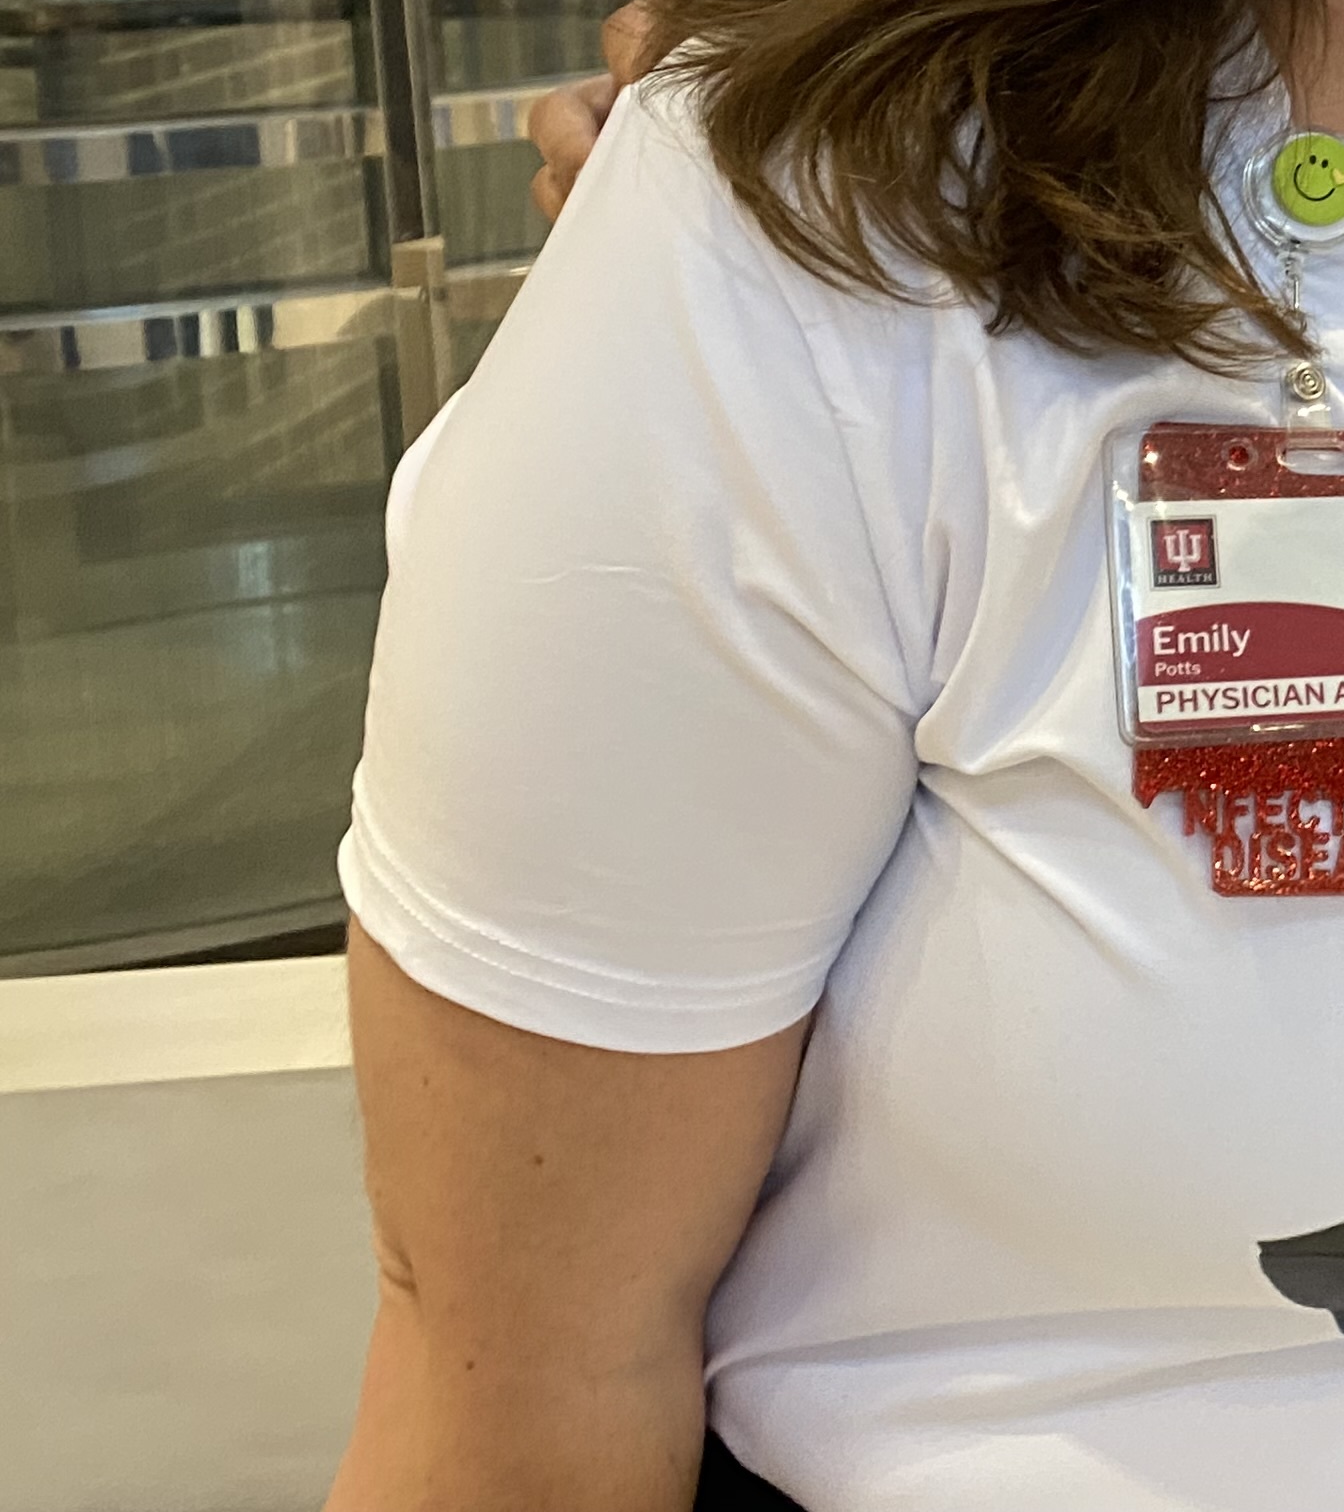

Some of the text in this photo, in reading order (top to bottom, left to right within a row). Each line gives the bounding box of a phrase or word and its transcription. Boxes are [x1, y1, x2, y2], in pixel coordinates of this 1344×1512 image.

[1157, 573, 1213, 585] HEALTH
[1152, 623, 1251, 657] Emily
[1154, 661, 1201, 678] Potts
[1155, 681, 1326, 715] PHYSICIAN
